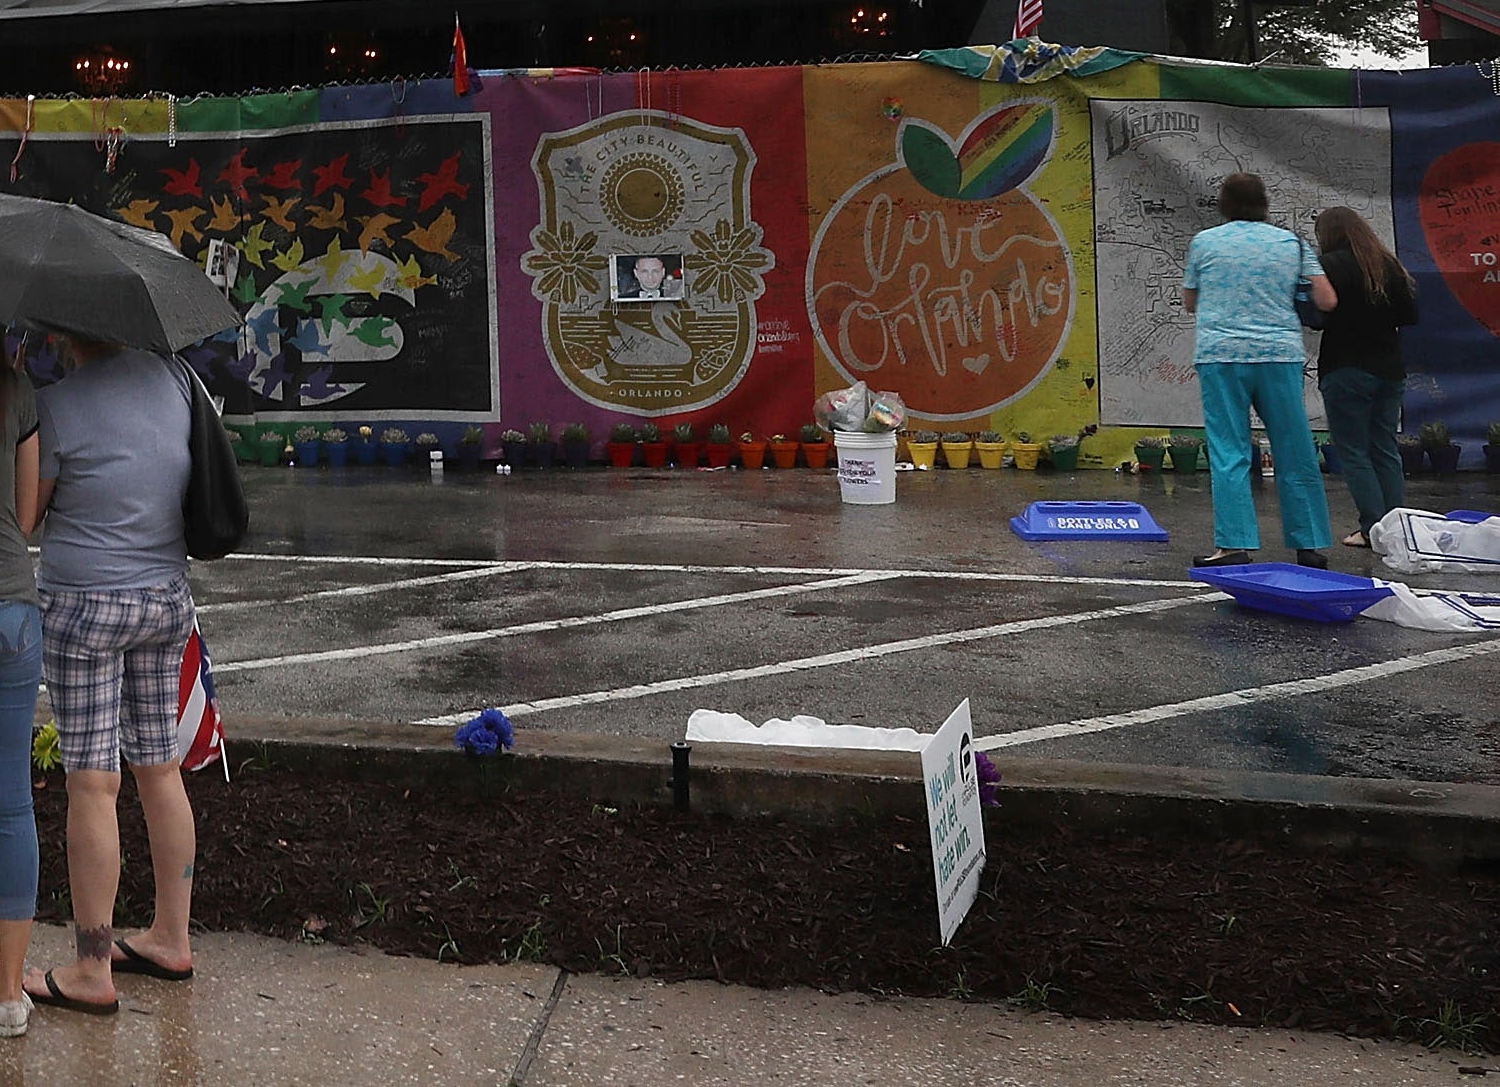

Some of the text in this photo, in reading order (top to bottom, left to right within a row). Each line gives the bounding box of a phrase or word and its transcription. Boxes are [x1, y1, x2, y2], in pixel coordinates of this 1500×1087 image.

[1105, 105, 1200, 161] ORLANDO
[580, 134, 706, 194] THE CITY BEAUTIFUL
[1470, 252, 1497, 266] TO
[1483, 270, 1500, 283] A
[618, 388, 683, 398] ORLANDO
[930, 751, 956, 810] We will
[935, 793, 958, 850] not let
[938, 845, 956, 888] hate
[955, 823, 971, 862] win.
